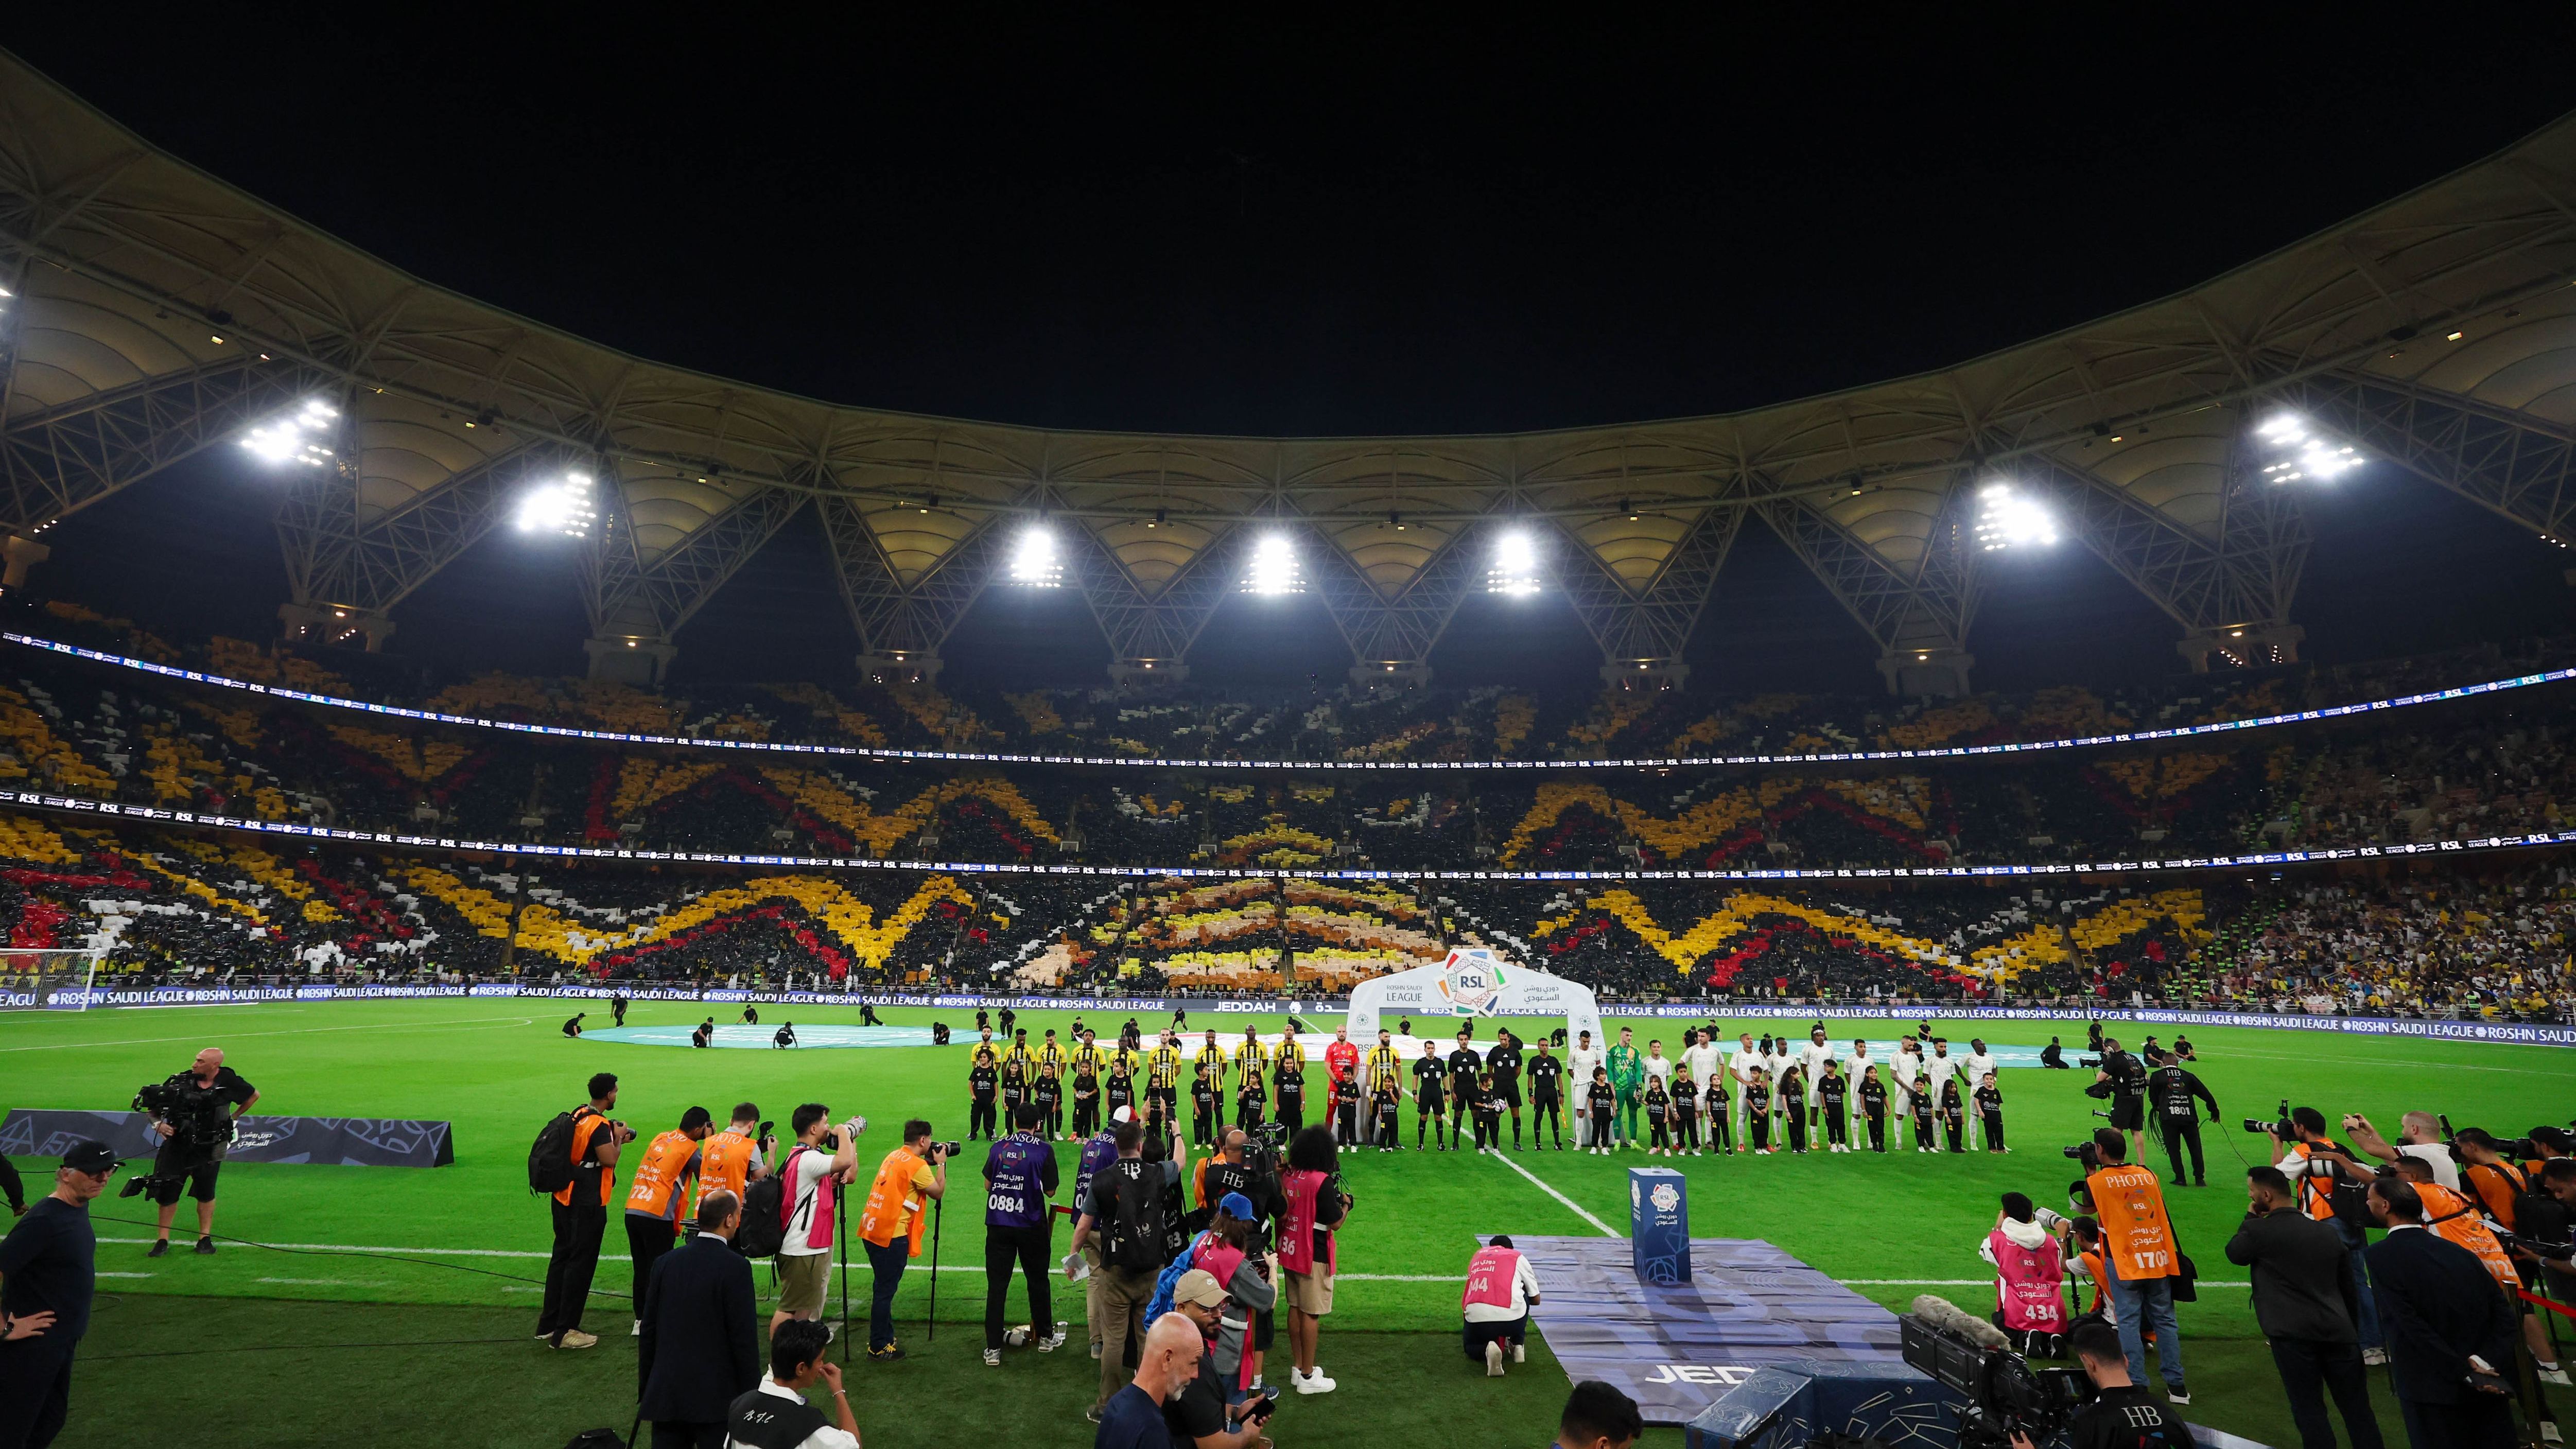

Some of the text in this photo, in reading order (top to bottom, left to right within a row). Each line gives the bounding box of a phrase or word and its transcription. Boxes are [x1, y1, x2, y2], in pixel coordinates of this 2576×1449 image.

[54, 643, 72, 653] RSL
[124, 658, 140, 668] RSL
[2521, 675, 2543, 685] RSL
[250, 684, 265, 692] RSL
[2445, 689, 2464, 697] RSL
[19, 794, 40, 804] RSL
[99, 804, 119, 813] RSL
[176, 813, 194, 822] RSL
[312, 828, 328, 836] RSL
[2528, 834, 2552, 843] RSL
[2441, 841, 2462, 850] RSL
[1460, 976, 1485, 988] RSL
[196, 989, 293, 1002] ROSHN SAUDI LEAGUE
[304, 987, 385, 998] ROSHN SAUDI LEAGUE
[390, 986, 465, 996] ROSHN SAUDI LEAGUE
[479, 987, 590, 998] ROSHN SAUDI LEAGUE
[633, 989, 665, 1000] SAUDI
[666, 991, 699, 1000] LEAGUE
[107, 992, 143, 1004] SAUDI
[144, 991, 185, 1003] LEAGUE
[711, 992, 815, 1003] ROSHN SAUDI LEAGUE
[826, 994, 929, 1005] ROSHN SAUDI LEAGUE
[943, 997, 1048, 1008] ROSHN SAUDI LEAGUE
[1386, 993, 1422, 1002] LEAGUE
[1524, 994, 1559, 1003] السعودي
[1059, 1000, 1164, 1010] ROSHN SAUDI LEAGUE
[1213, 1002, 1276, 1012] JEDDAH
[1616, 1007, 1653, 1016] LEAGUE
[1666, 1007, 1771, 1017] ROSHN SAUDI LEAGUE
[1783, 1008, 1888, 1018] ROSHN SAUDI LEAGUE
[1901, 1009, 2006, 1018] ROSHN SAUDI LEAGUE
[2017, 1010, 2050, 1019] ROSHN
[2053, 1010, 2084, 1019] SAUDI
[2146, 1012, 2233, 1024] ROSHN SAUDI LEAGUE
[2241, 1016, 2338, 1030] ROSHN SAUDI LEAGUE
[2352, 1021, 2474, 1037] ROSHN SAUDI LEAGUE
[2488, 1027, 2535, 1040] ROSHN
[2168, 1106, 2190, 1115] 1801
[237, 1140, 270, 1148] السعودي
[1221, 1171, 1244, 1188] HB
[2105, 1174, 2154, 1188] PHOTO
[630, 1184, 655, 1202] 724
[988, 1194, 1024, 1213] 0884
[2129, 1226, 2148, 1235] روشن
[2017, 1291, 2052, 1299] السعودي
[2025, 1304, 2059, 1320] 434
[2121, 1406, 2163, 1427] HB
